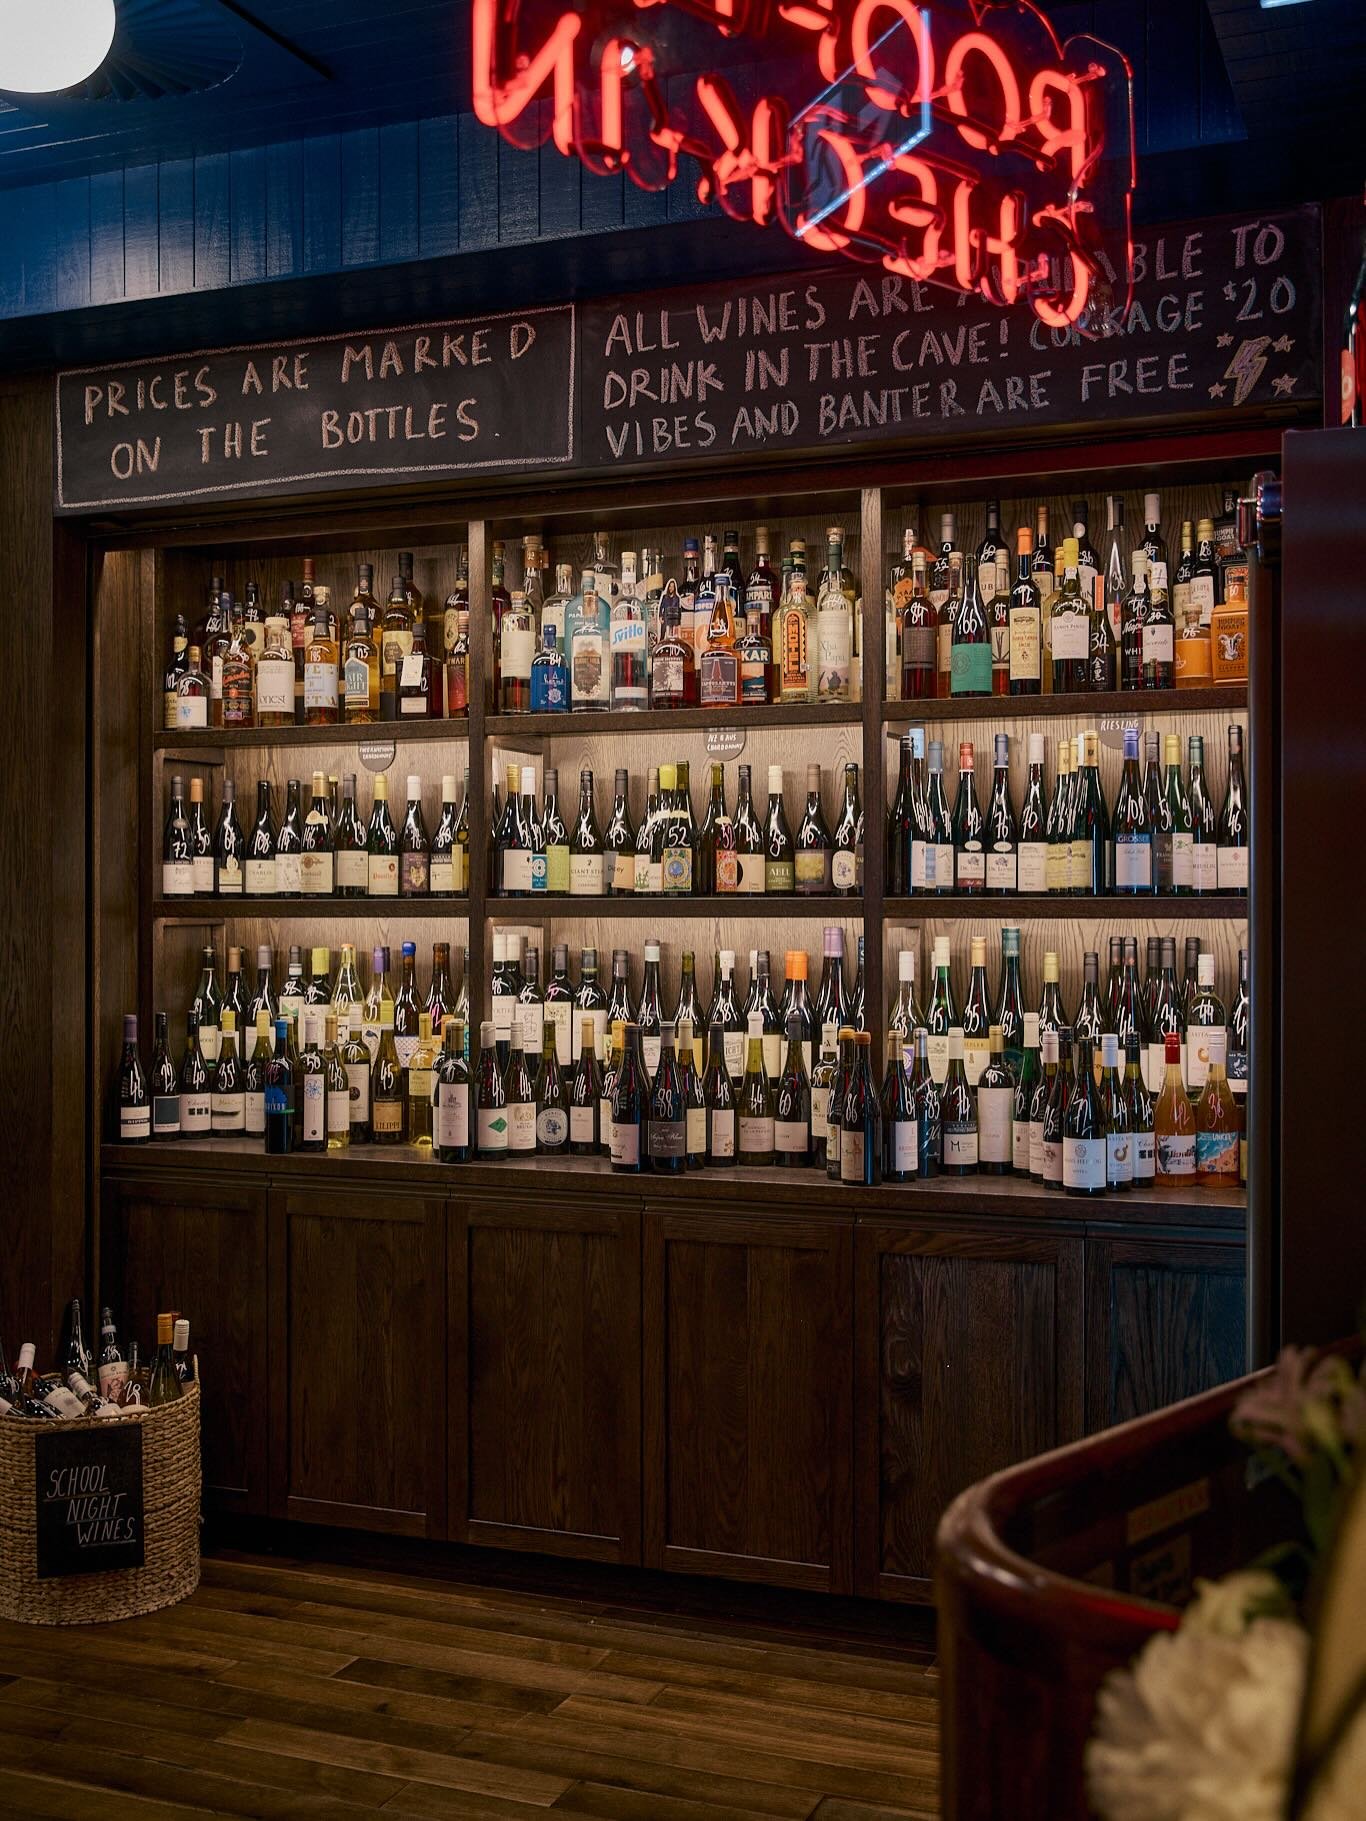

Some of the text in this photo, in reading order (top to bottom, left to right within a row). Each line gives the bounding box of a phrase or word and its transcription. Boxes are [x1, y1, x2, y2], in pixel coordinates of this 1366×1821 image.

[604, 311, 680, 356] ALL
[697, 285, 826, 343] WINES
[848, 274, 936, 321] ARE
[1230, 220, 1286, 269] TO
[604, 359, 726, 410] DRINK
[745, 347, 789, 391] IN
[804, 332, 879, 384] THE
[892, 316, 1009, 373] CAVE!
[1221, 273, 1297, 322] $20
[84, 366, 218, 425] PRICES
[242, 353, 310, 395] ARE
[605, 353, 1194, 458] VIBES AND BANTER ARE FREE
[111, 435, 161, 481] ON
[197, 416, 272, 464] THE
[1091, 618, 1109, 653] 34
[1100, 719, 1139, 731] RIESLING
[1127, 795, 1145, 826] 108
[669, 825, 691, 848] 52
[657, 1088, 673, 1118] 88
[779, 1090, 791, 1115] 60
[846, 1094, 858, 1123] 86
[46, 1465, 110, 1499] SCHOOL
[66, 1492, 128, 1523] NIGHT
[76, 1516, 136, 1546] WINES
